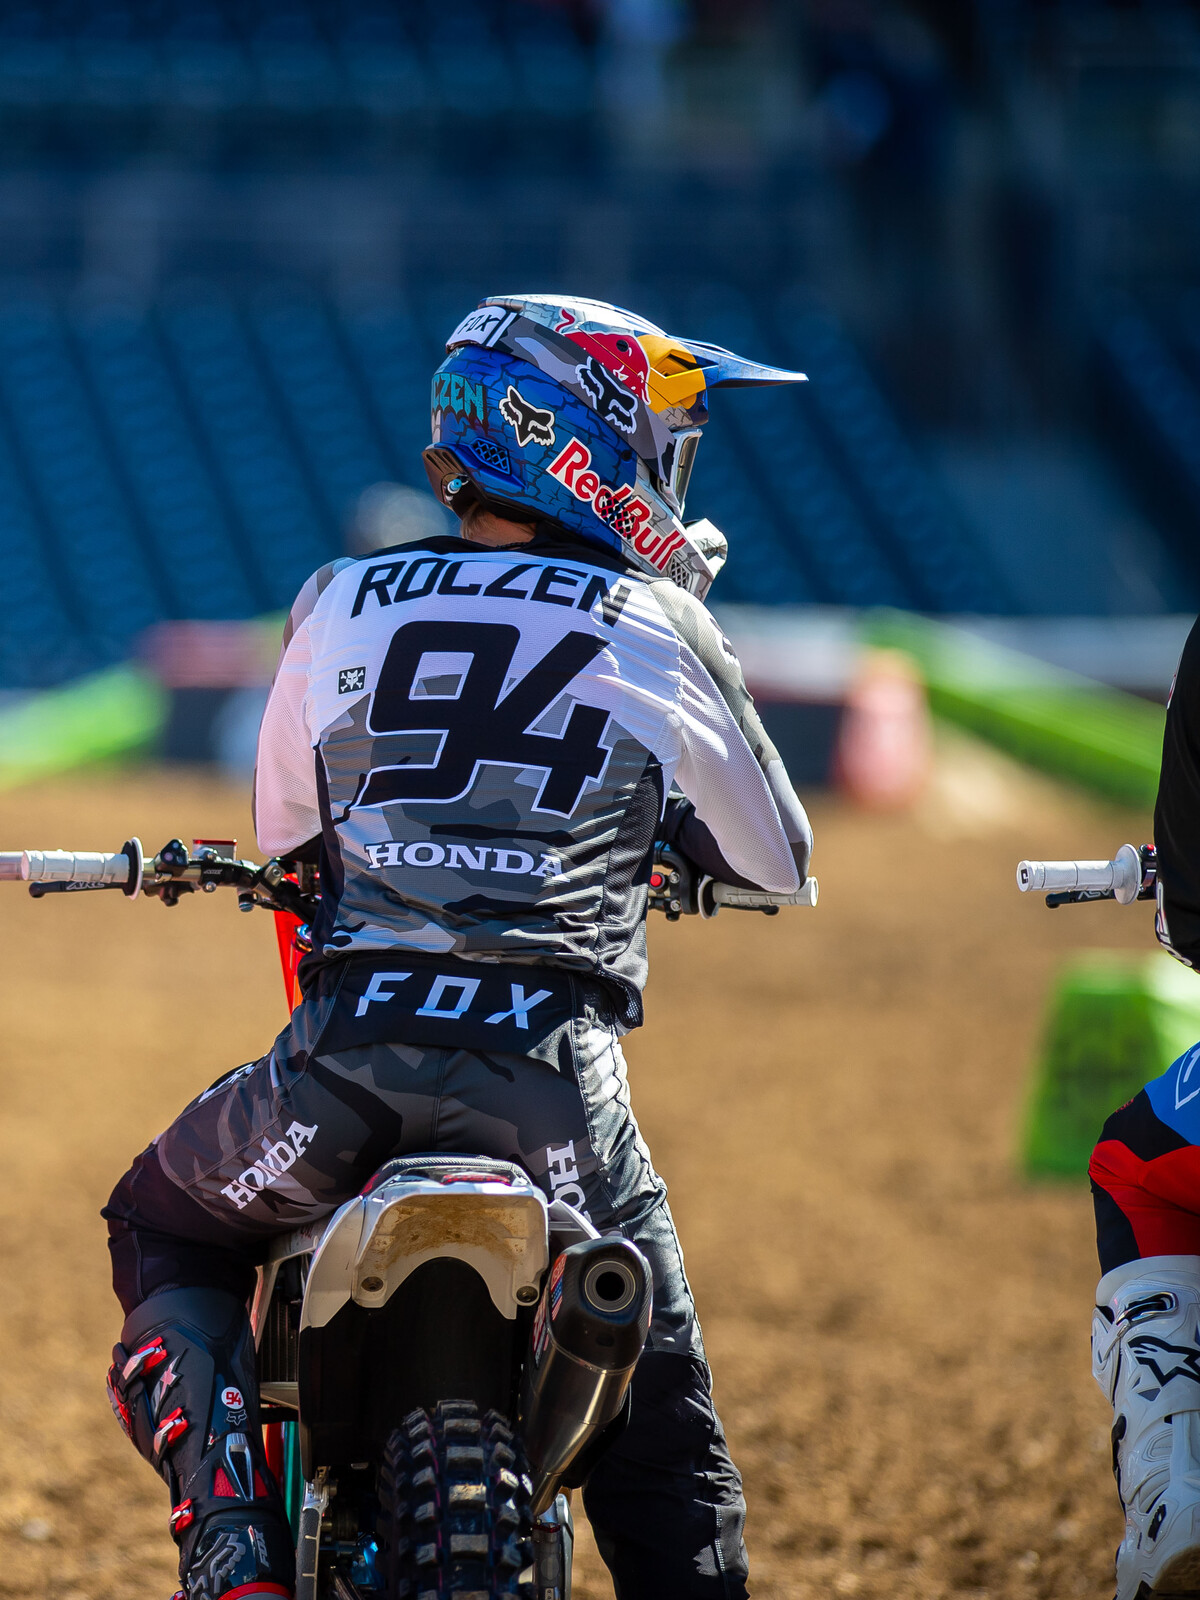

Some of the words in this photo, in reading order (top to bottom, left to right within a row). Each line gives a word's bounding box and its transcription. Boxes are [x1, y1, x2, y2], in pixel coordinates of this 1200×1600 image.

[457, 314, 501, 335] FOX
[548, 440, 633, 521] Red
[611, 498, 687, 572] Bull
[350, 557, 631, 628] ROCZEN
[350, 619, 614, 819] 94
[364, 841, 572, 888] HONDA
[355, 972, 554, 1030] FOX
[220, 1120, 319, 1210] HONDA
[225, 1391, 243, 1406] 94
